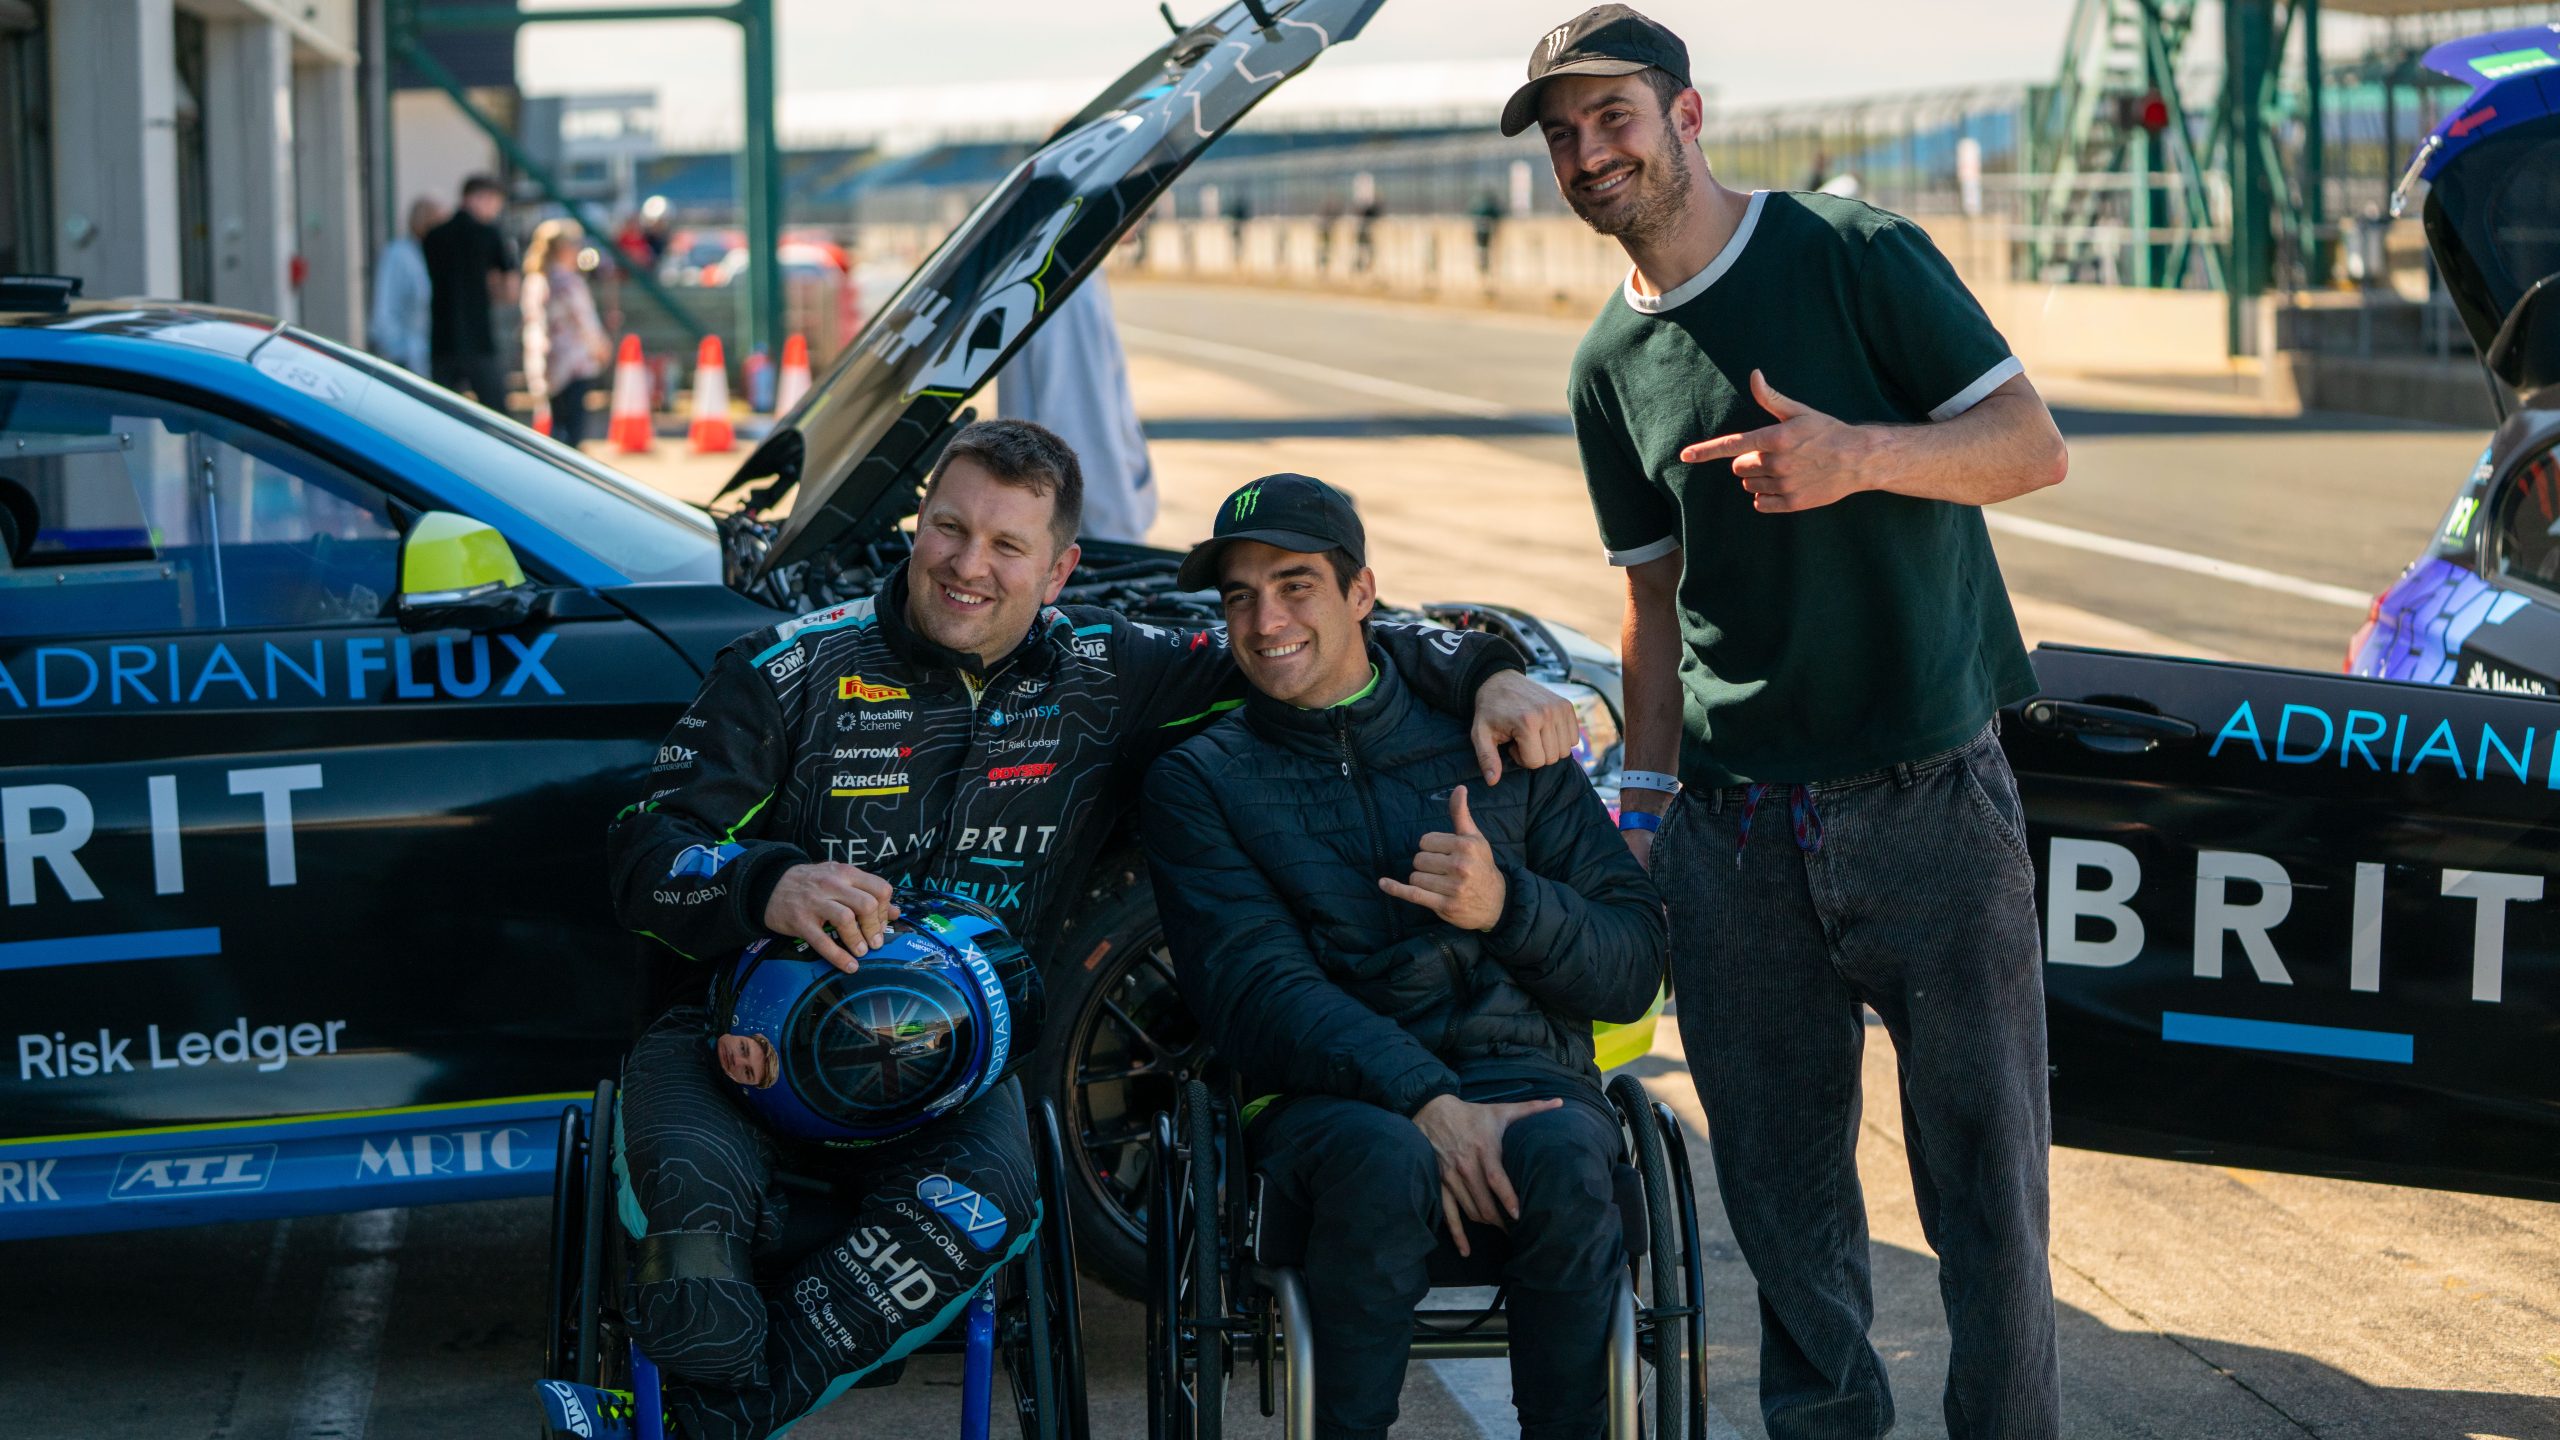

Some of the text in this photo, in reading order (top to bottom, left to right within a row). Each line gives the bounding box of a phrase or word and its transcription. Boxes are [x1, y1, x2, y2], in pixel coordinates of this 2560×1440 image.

[768, 643, 806, 680] OMP
[860, 710, 913, 721] Motability
[860, 720, 901, 731] Scheme
[1005, 704, 1060, 724] phinsys
[834, 747, 899, 758] DAYTONA
[1008, 738, 1060, 749] Risk Ledger
[832, 773, 909, 787] KÄRCHER
[988, 763, 1057, 780] ODYSSEY
[989, 777, 1049, 788] BATTERY
[820, 825, 1056, 867] TEAM BRIT
[2047, 836, 2544, 1003] BRIT
[960, 943, 1008, 1086] ADRIANFLUX
[18, 1017, 346, 1081] Risk Ledger
[118, 1153, 264, 1191] ATL
[356, 1128, 532, 1180] MRTC
[896, 1202, 971, 1271] QAV.GLOBAL
[849, 1225, 937, 1310] SHD
[545, 1381, 592, 1438] OMP
